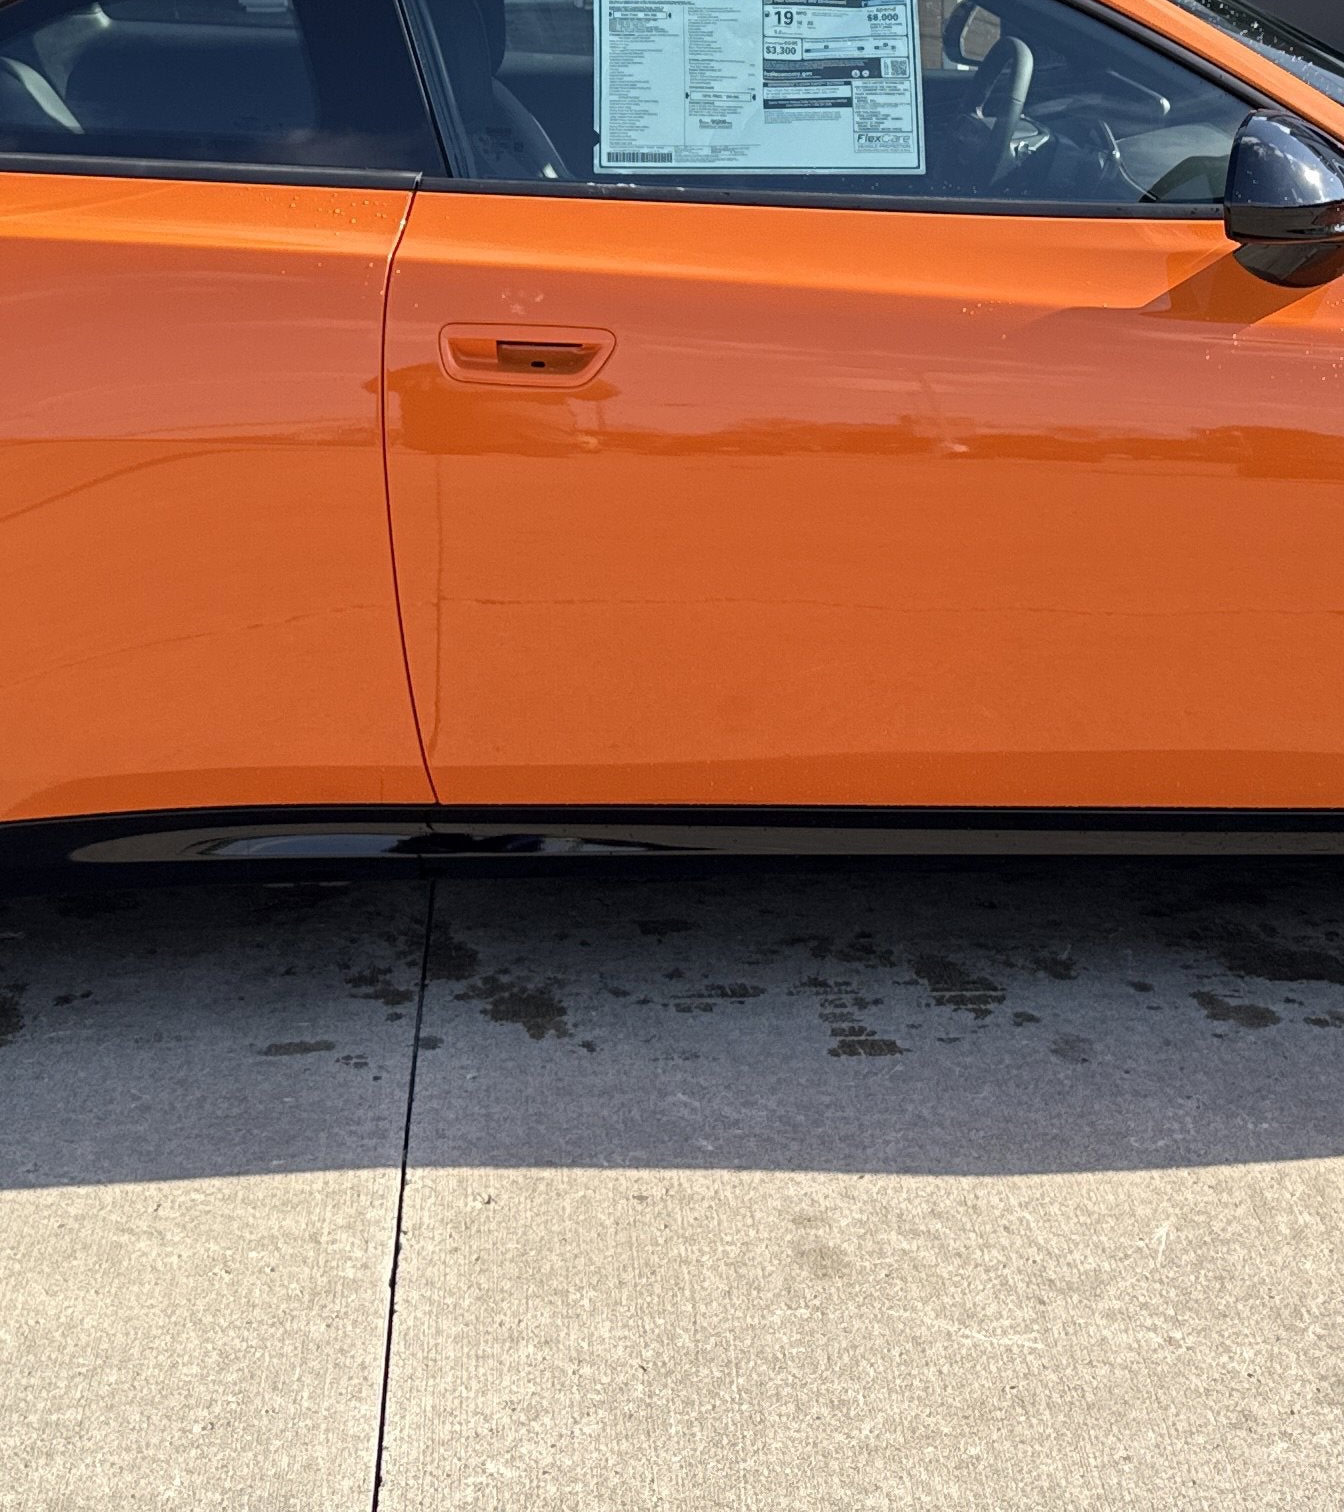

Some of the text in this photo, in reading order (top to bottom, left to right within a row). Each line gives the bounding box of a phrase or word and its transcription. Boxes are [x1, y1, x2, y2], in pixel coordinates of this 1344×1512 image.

[774, 10, 794, 25] 19
[766, 46, 796, 55] $3,300
[857, 134, 911, 143] FlexCare
